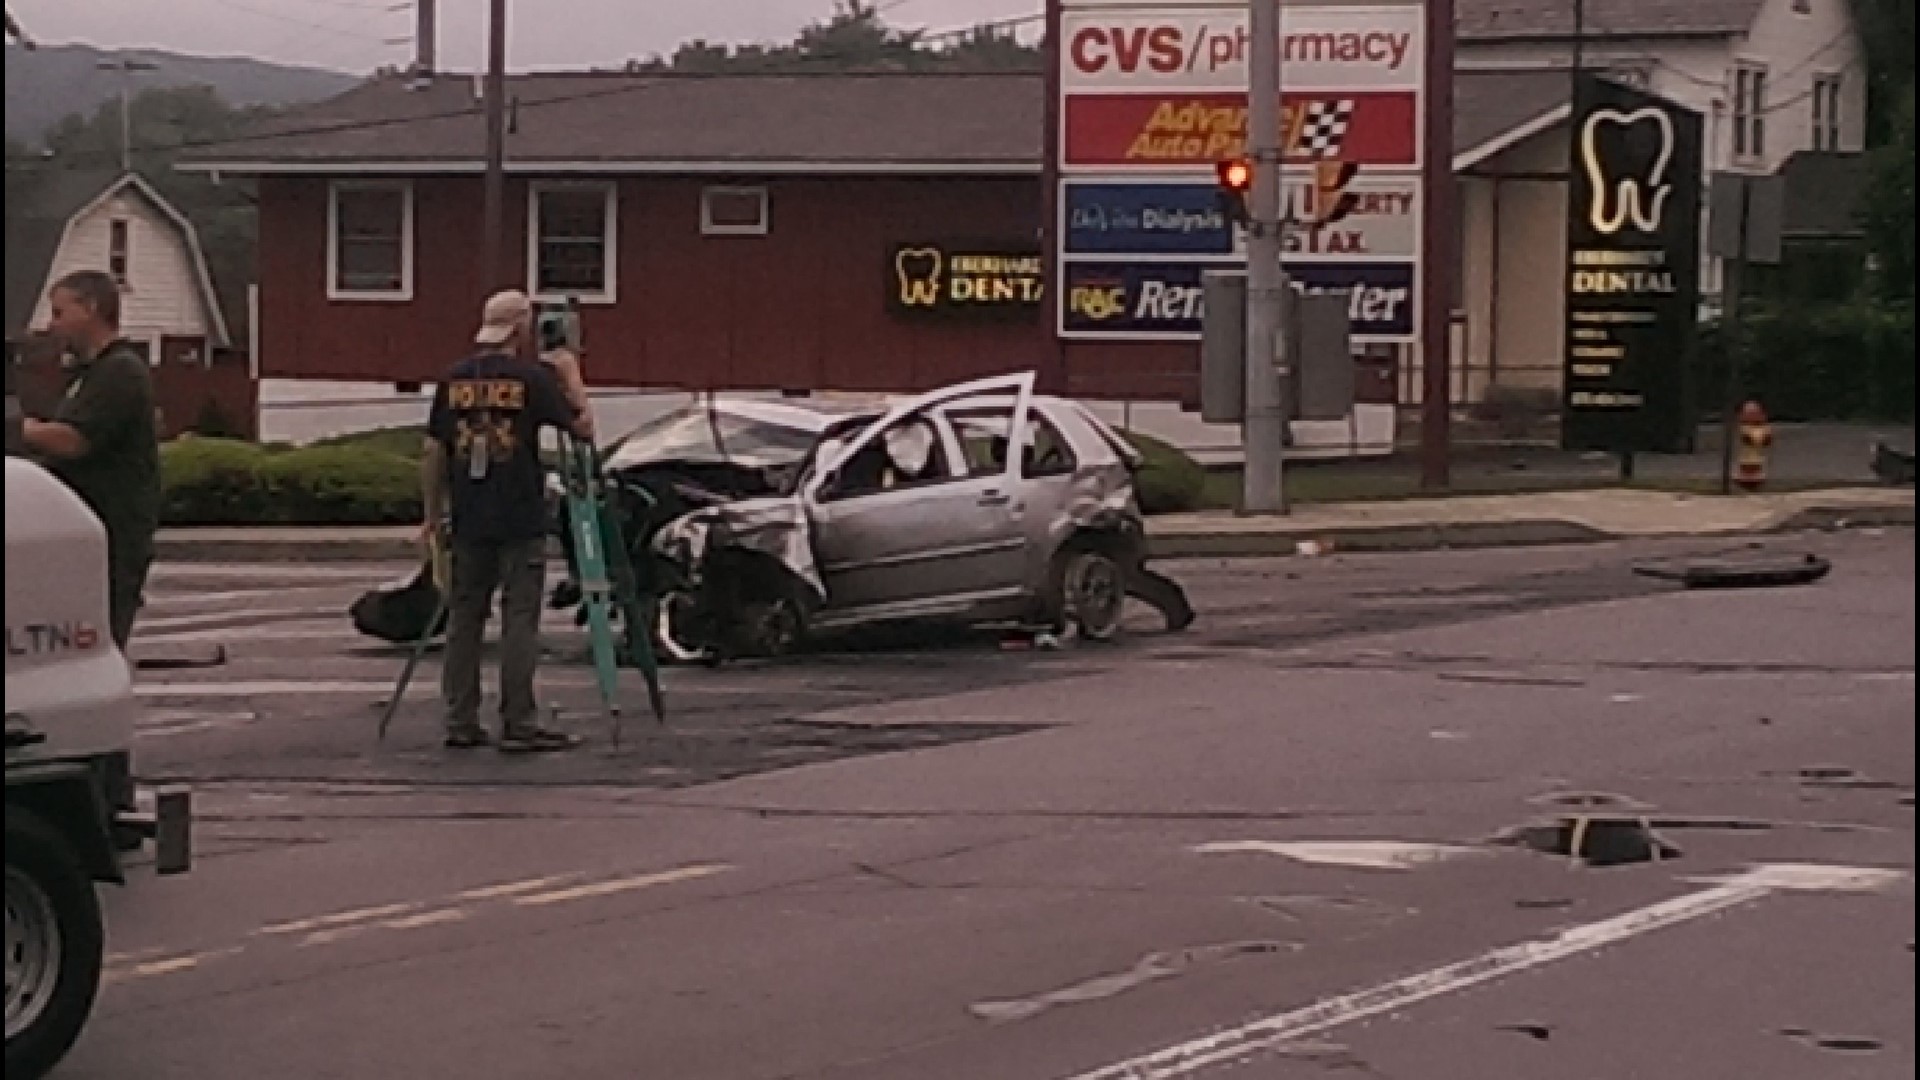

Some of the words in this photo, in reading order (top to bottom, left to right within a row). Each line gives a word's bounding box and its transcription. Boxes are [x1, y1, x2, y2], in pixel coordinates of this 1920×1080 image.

[1070, 25, 1411, 73] CVS/phrmacy
[1145, 102, 1296, 132] Advane
[1125, 133, 1204, 158] Auto
[950, 277, 1044, 301] DENT
[1572, 272, 1677, 293] DENTAL
[449, 381, 525, 410] POLICE
